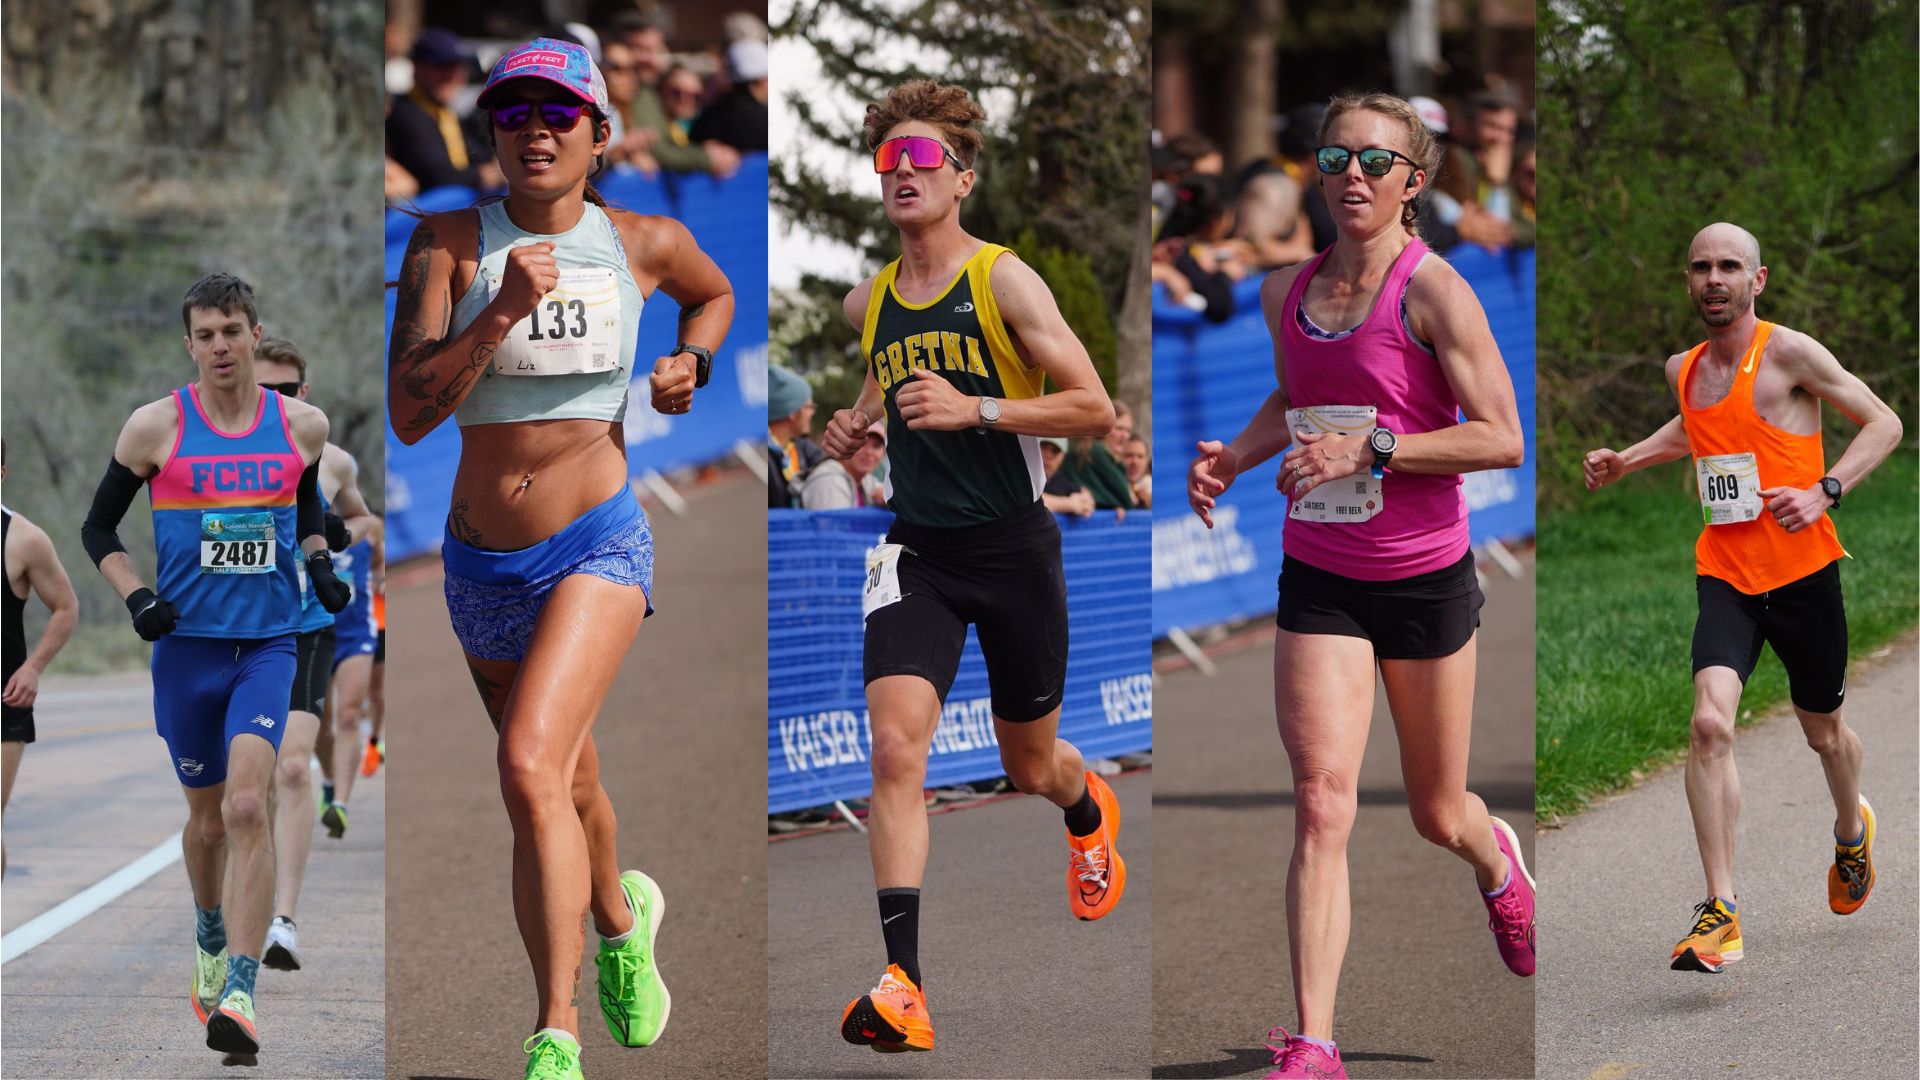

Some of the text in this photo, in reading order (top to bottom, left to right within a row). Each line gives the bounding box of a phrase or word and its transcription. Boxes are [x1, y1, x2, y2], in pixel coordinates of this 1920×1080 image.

[541, 55, 562, 63] FEET
[528, 299, 588, 341] 133
[874, 331, 990, 391] GRETNA
[191, 460, 283, 495] FCRC
[1708, 473, 1739, 502] 609
[1335, 505, 1362, 515] FREE BEER
[211, 541, 269, 566] 2487
[779, 709, 866, 772] KAISER
